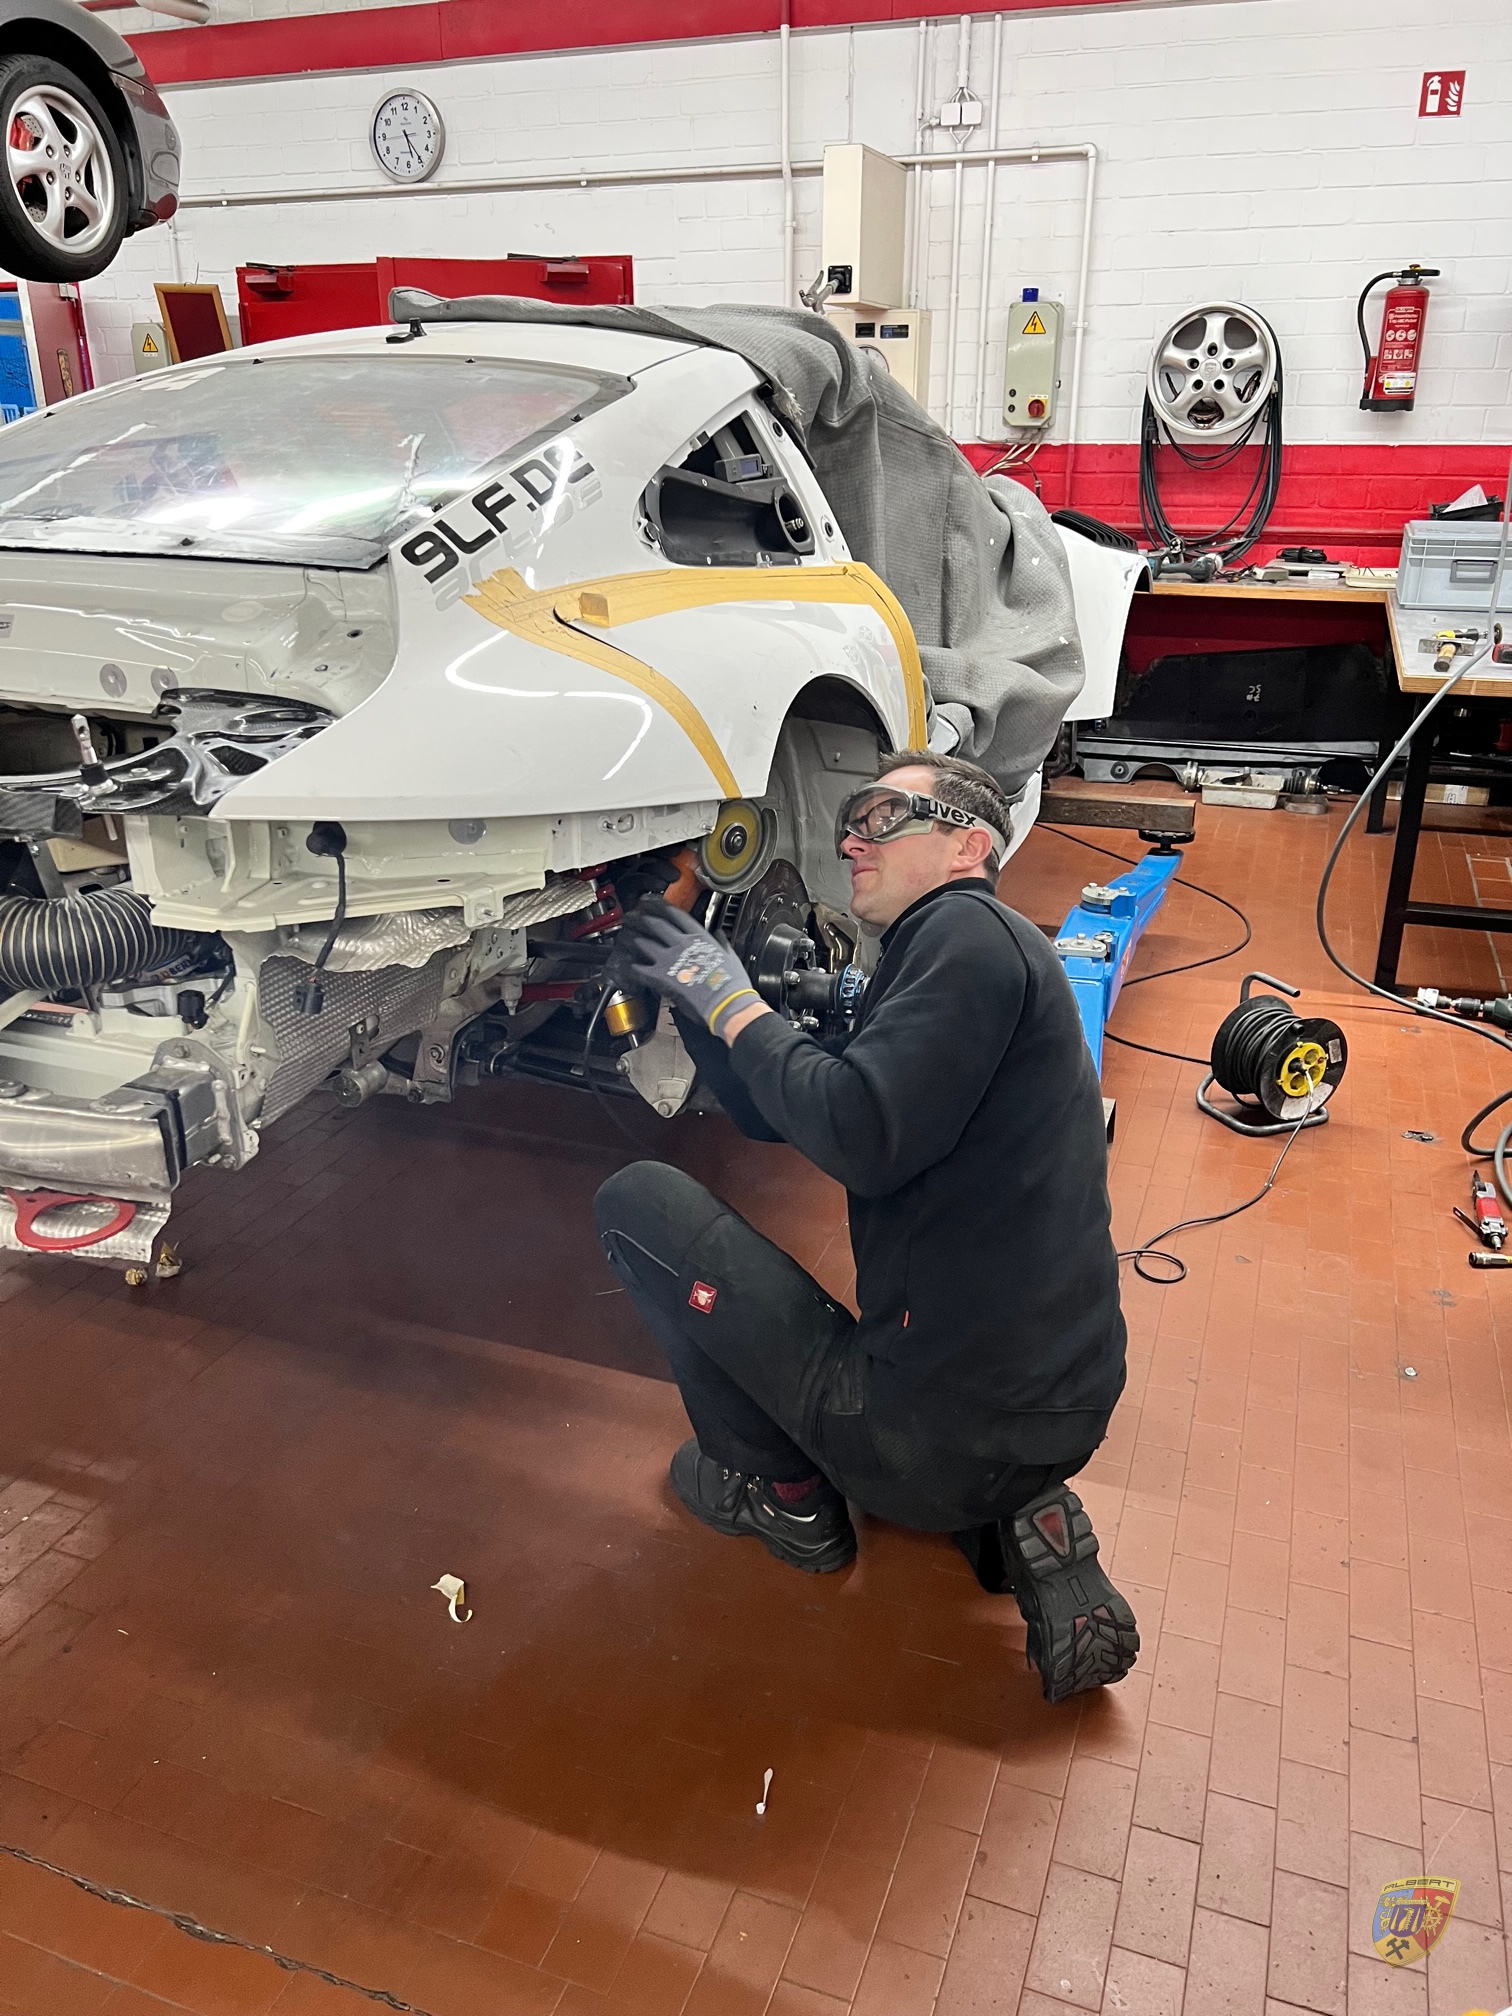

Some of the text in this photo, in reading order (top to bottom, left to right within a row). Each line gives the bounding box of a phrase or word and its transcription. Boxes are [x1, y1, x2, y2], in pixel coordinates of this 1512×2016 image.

[401, 102, 409, 111] 12
[414, 106, 418, 114] 1
[391, 107, 398, 116] 11
[384, 118, 391, 126] 10
[423, 116, 428, 125] 2
[382, 133, 387, 141] 9
[427, 130, 432, 138] 3
[386, 146, 391, 155] 8
[425, 144, 429, 152] 4
[395, 157, 400, 165] 7
[407, 160, 411, 169] 6
[928, 800, 977, 827] uvex
